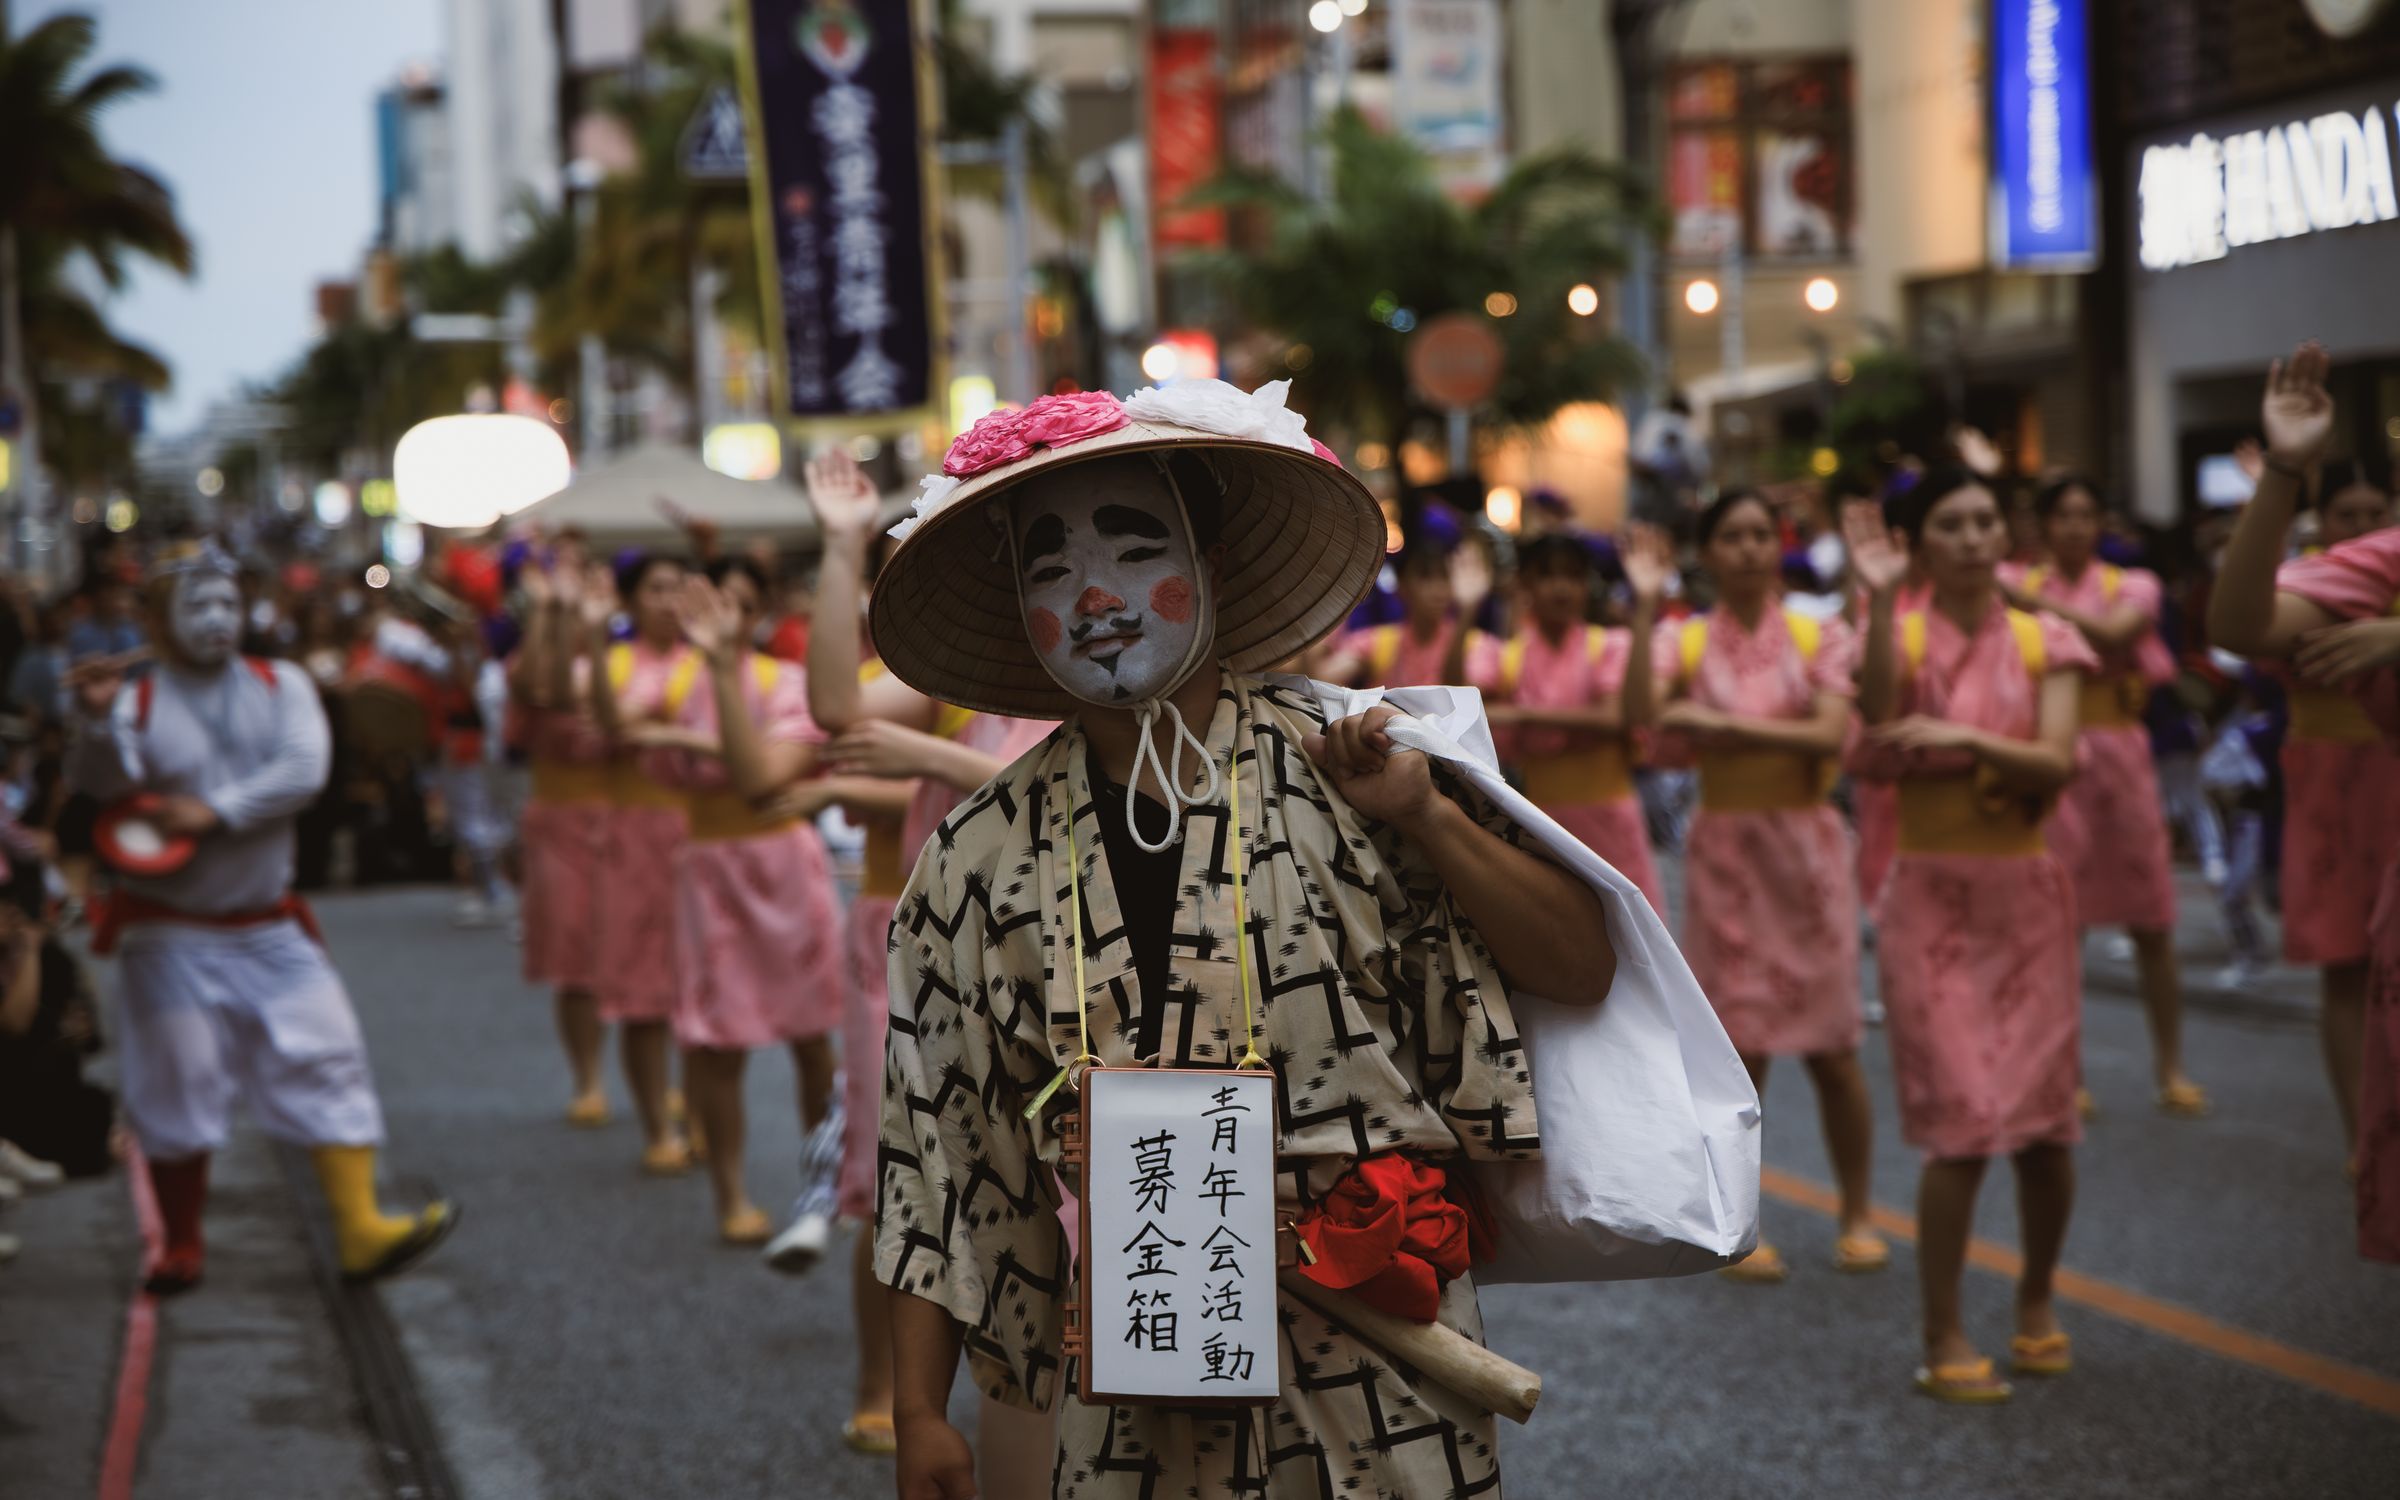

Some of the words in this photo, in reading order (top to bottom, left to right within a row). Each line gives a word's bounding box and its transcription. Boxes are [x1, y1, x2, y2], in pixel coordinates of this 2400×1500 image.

[2223, 100, 2400, 247] HANDA
[1122, 1129, 1186, 1352] 募金箱
[1199, 1086, 1255, 1382] 青年会活動
